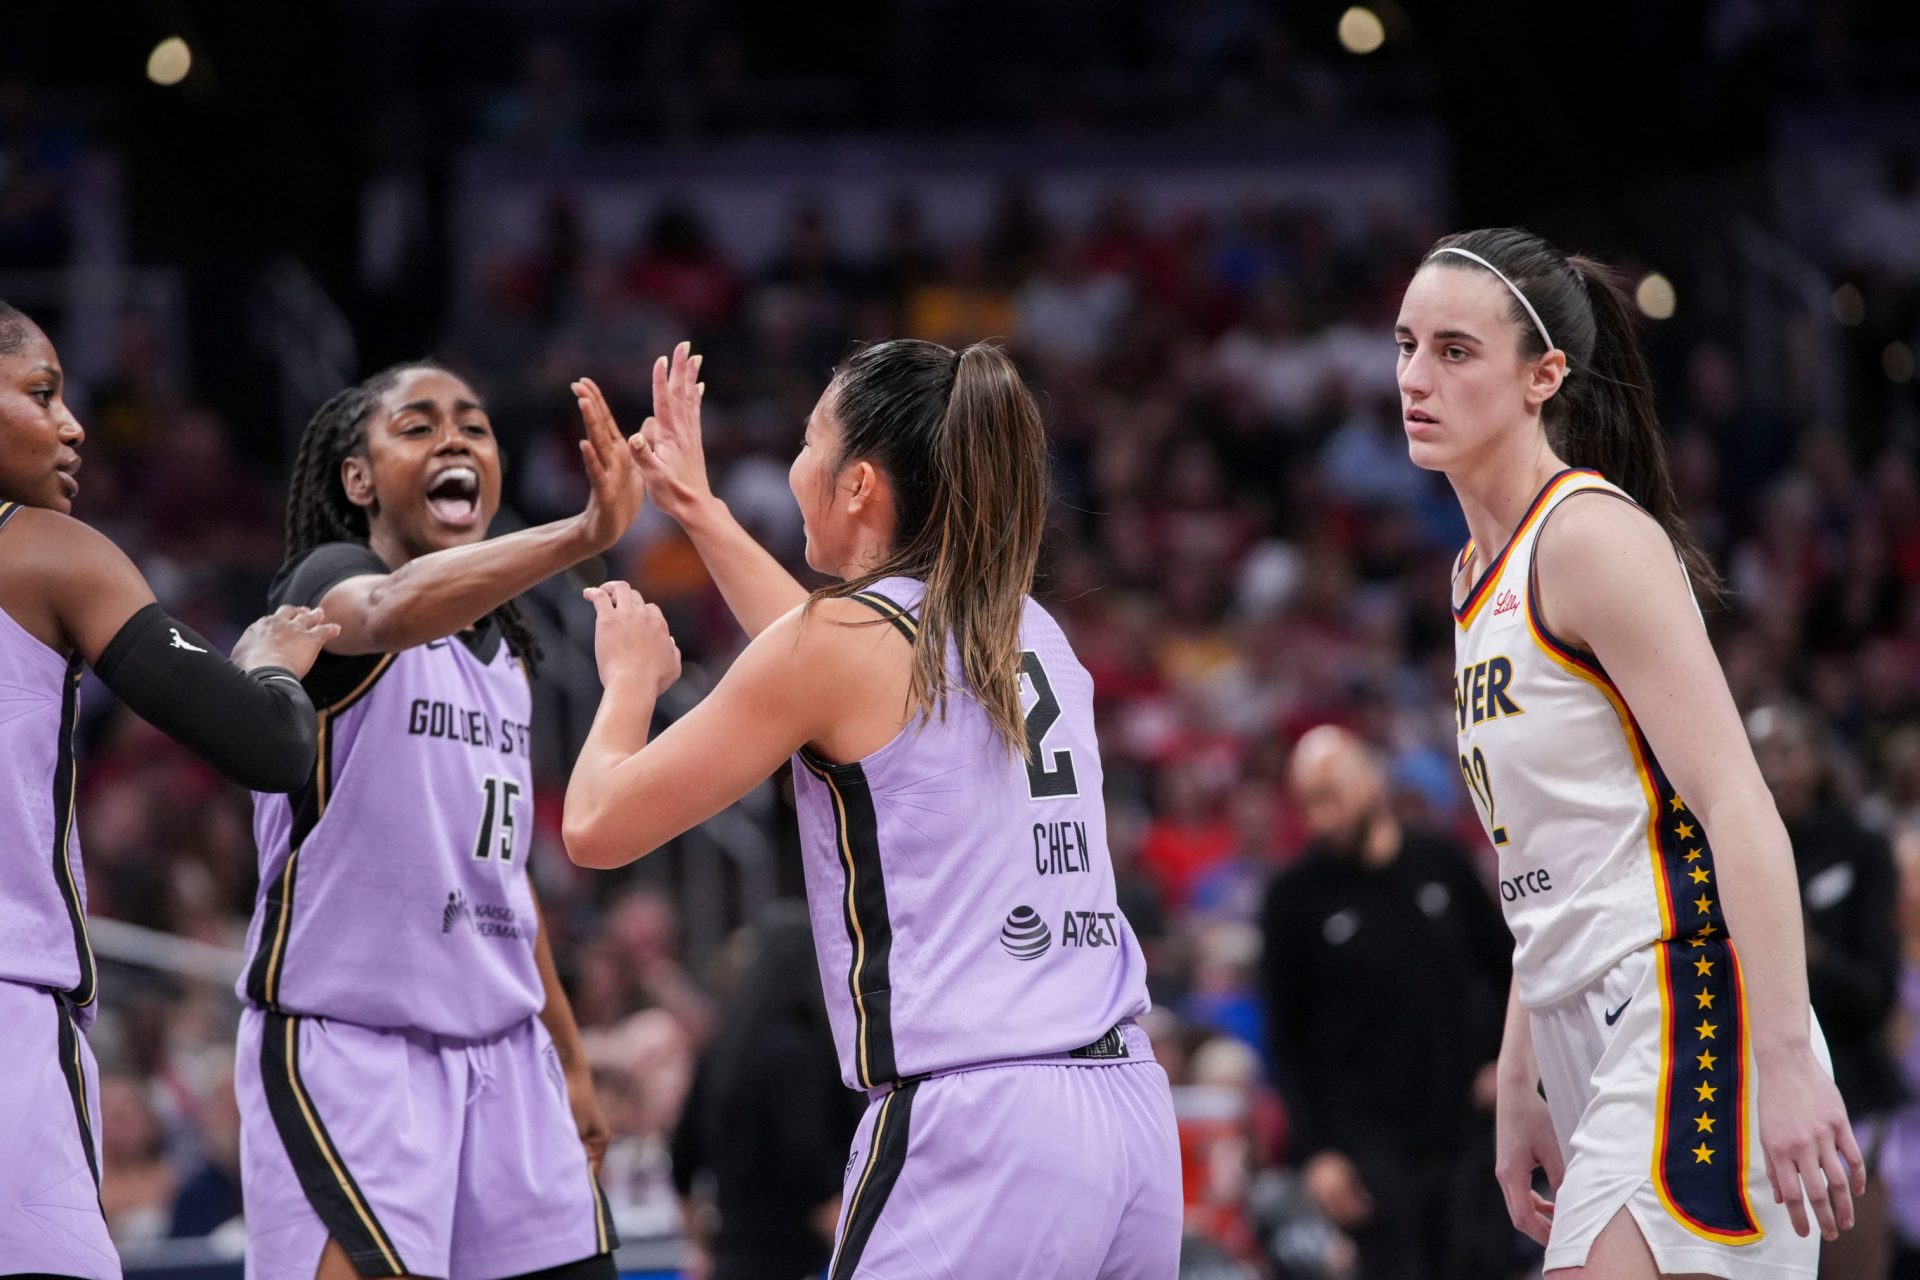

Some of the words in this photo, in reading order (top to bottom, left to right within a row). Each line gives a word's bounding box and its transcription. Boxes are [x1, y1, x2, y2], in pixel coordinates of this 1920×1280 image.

[1493, 588, 1521, 618] Lilly
[1455, 655, 1525, 735] VER
[408, 698, 495, 749] GOLDEN
[1016, 648, 1080, 801] 2
[471, 773, 522, 866] 15
[1033, 820, 1090, 877] CHEN
[1500, 868, 1553, 902] orce
[1062, 911, 1118, 948] AT&T
